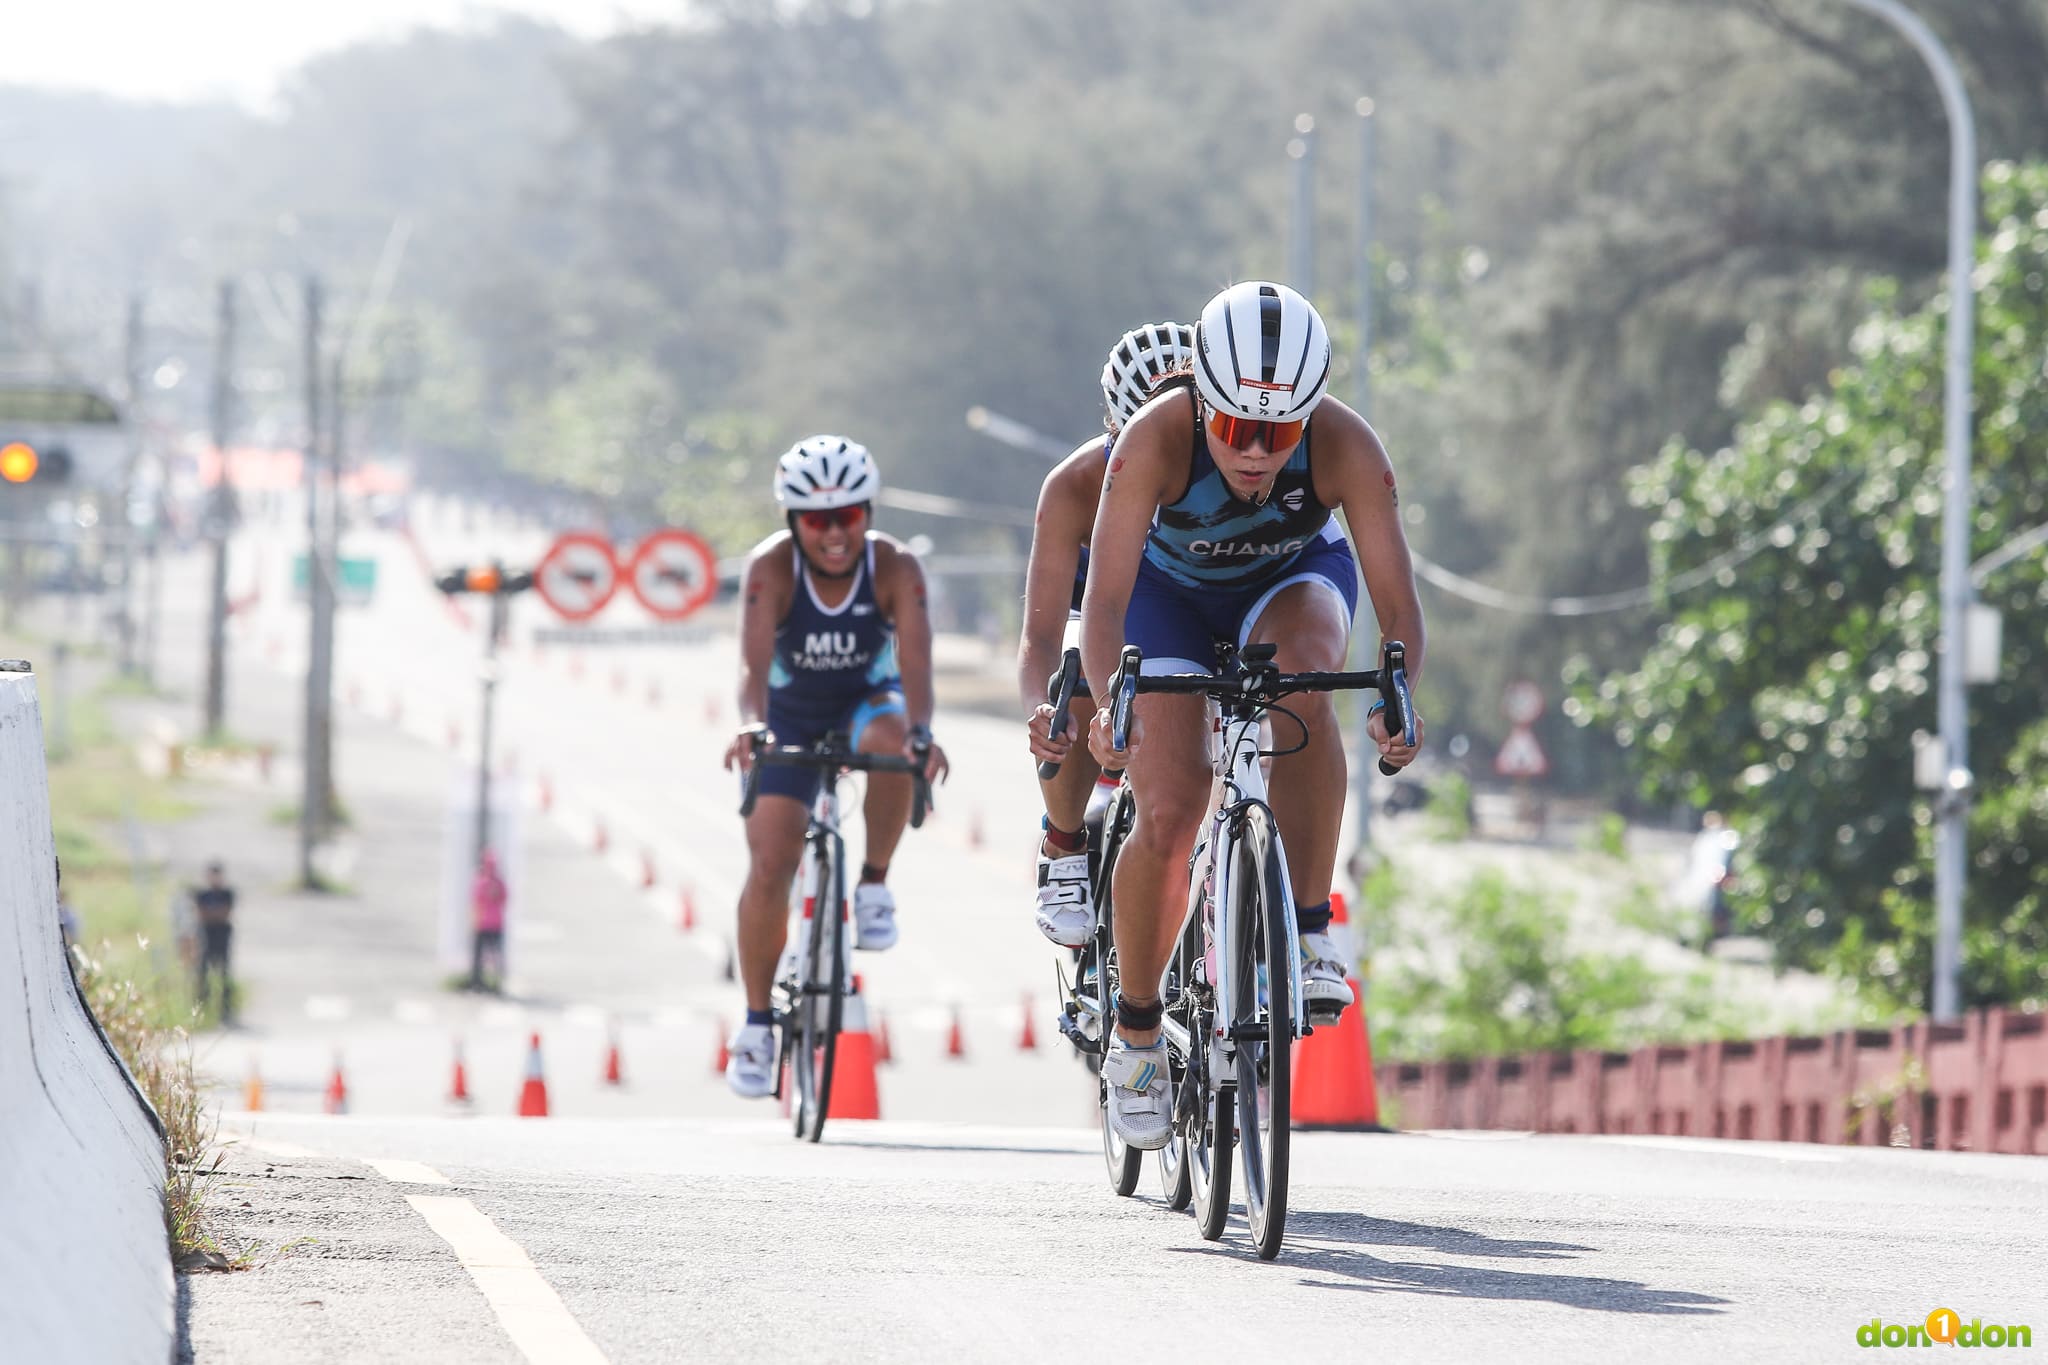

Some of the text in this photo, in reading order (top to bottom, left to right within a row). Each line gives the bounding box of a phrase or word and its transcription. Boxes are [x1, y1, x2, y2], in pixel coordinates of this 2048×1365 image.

[1259, 391, 1270, 407] 5
[1188, 540, 1303, 557] CHANG
[805, 631, 856, 656] MU
